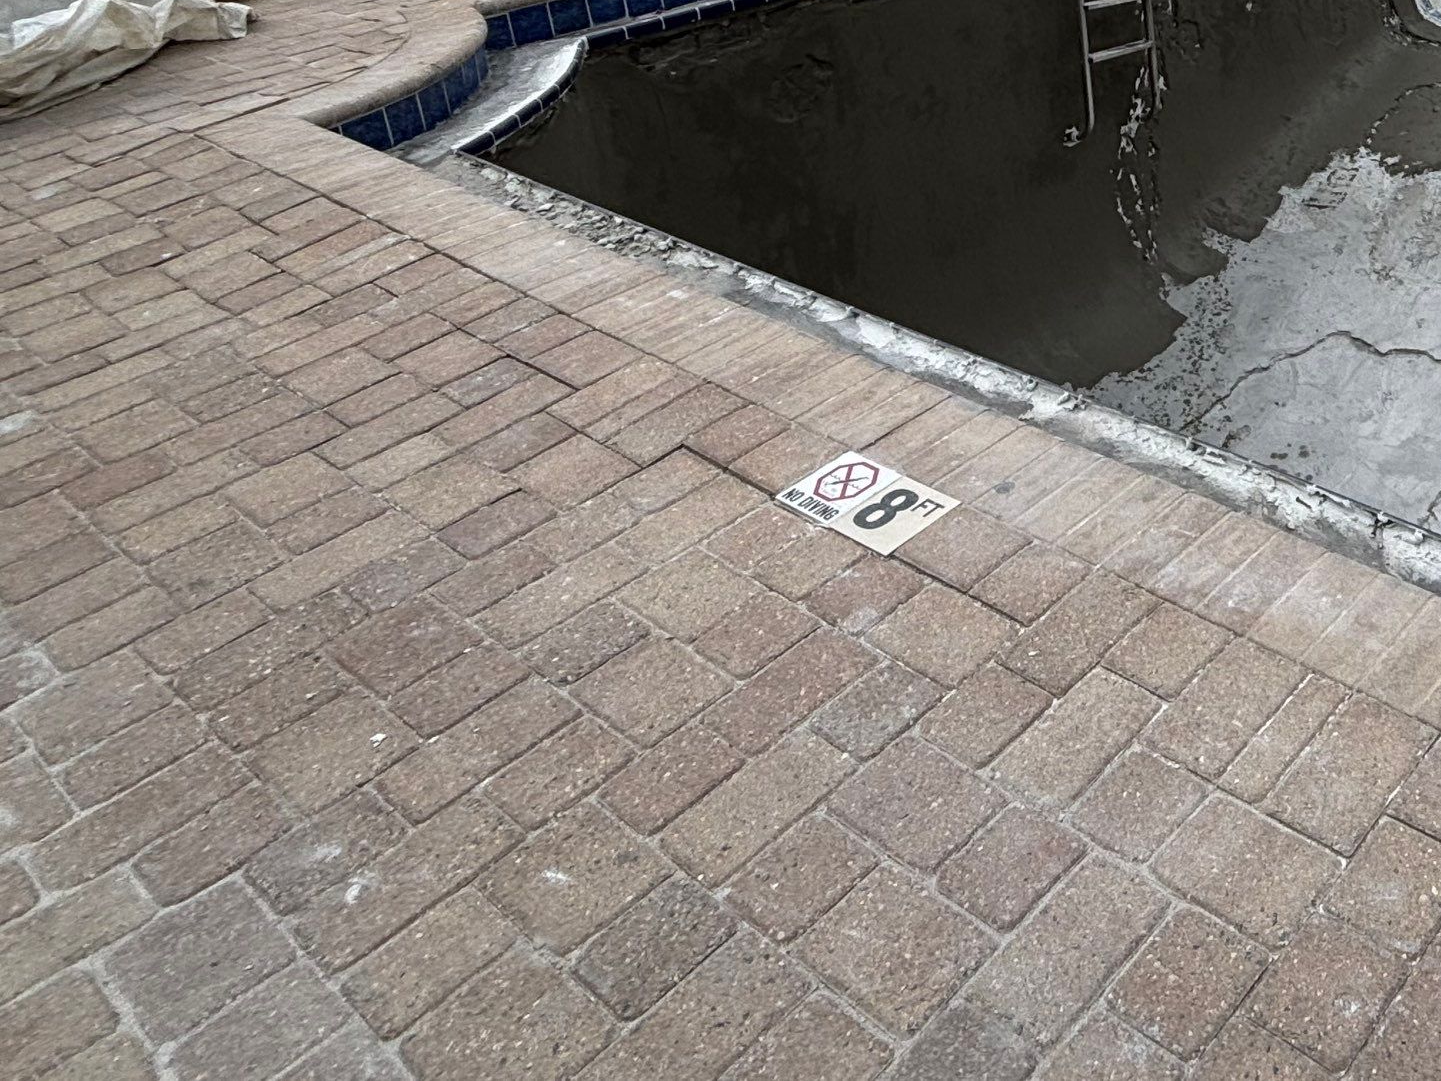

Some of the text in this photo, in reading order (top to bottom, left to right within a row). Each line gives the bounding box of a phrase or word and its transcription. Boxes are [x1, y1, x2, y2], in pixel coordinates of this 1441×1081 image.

[781, 487, 840, 521] NO DIVING
[853, 488, 945, 530] 8 FT
